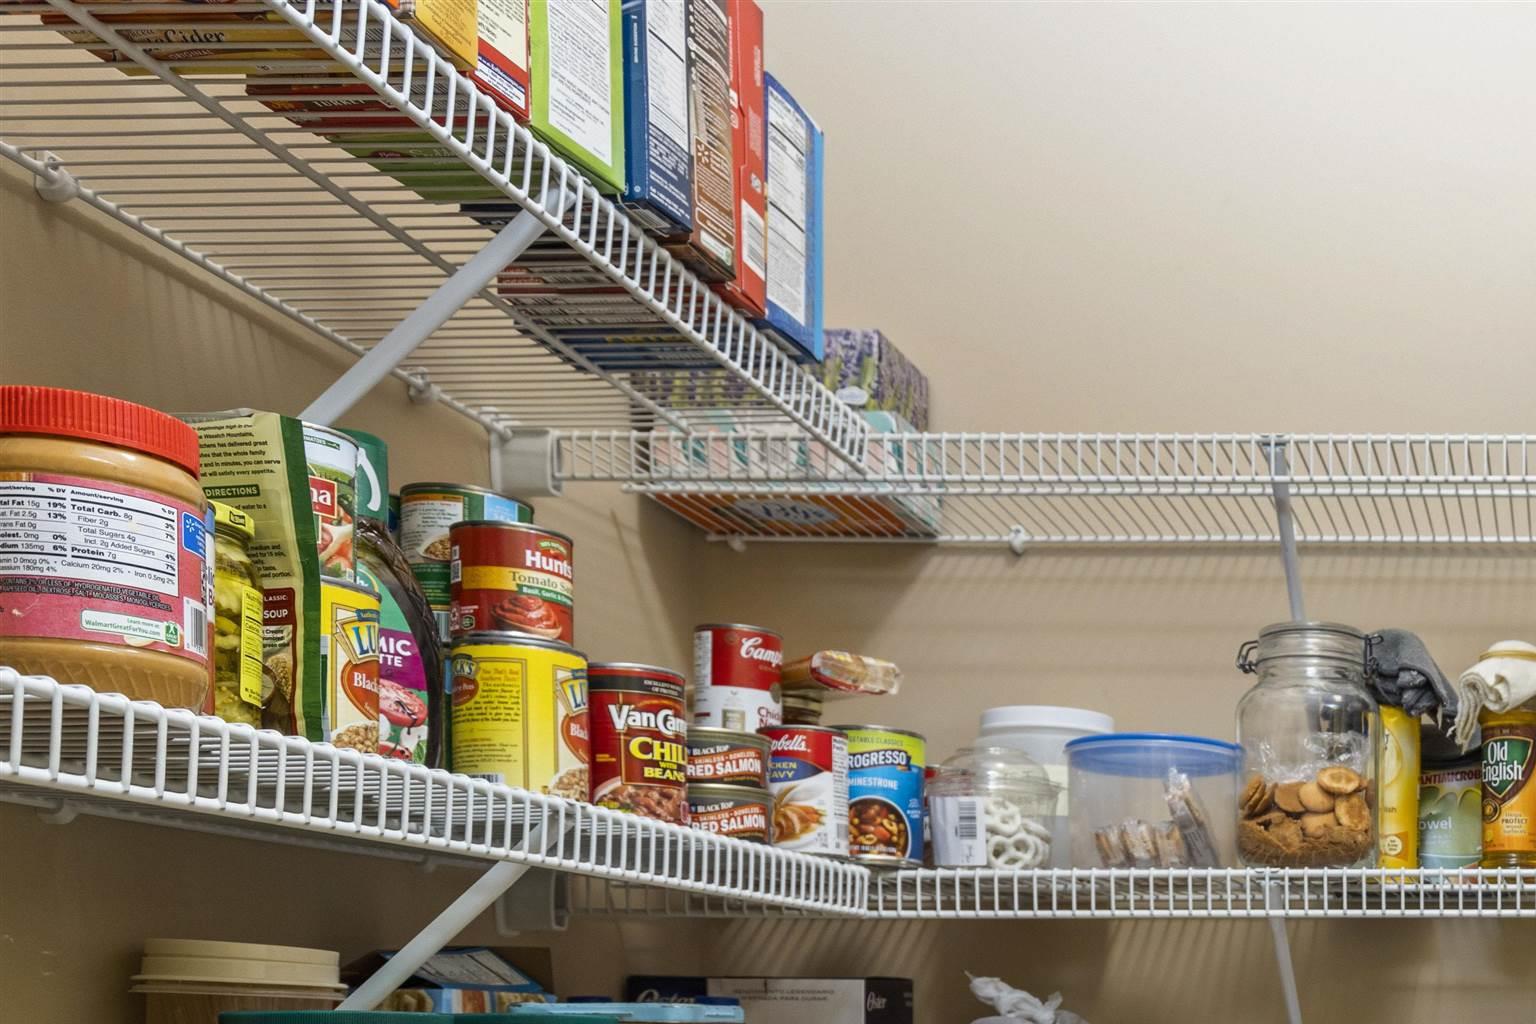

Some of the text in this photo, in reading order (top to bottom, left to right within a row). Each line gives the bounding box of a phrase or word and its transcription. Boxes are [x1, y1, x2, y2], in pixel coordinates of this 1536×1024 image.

[205, 486, 258, 497] DIRECTIONS
[71, 503, 95, 513] Total
[77, 515, 97, 524] Fiber
[99, 529, 126, 540] Sugars
[71, 546, 105, 556] Protein
[61, 559, 90, 569] Calcium
[508, 570, 558, 589] Tomato
[263, 608, 289, 618] SOUP
[693, 745, 730, 756] BLACK TOP
[1487, 741, 1508, 763] Old
[687, 758, 761, 777] RED SALMON
[644, 767, 685, 783] BEANS
[1482, 760, 1523, 790] English
[697, 802, 734, 813] BLACK TOP
[692, 814, 766, 833] RED SALMON
[1501, 817, 1528, 825] PROTECT
